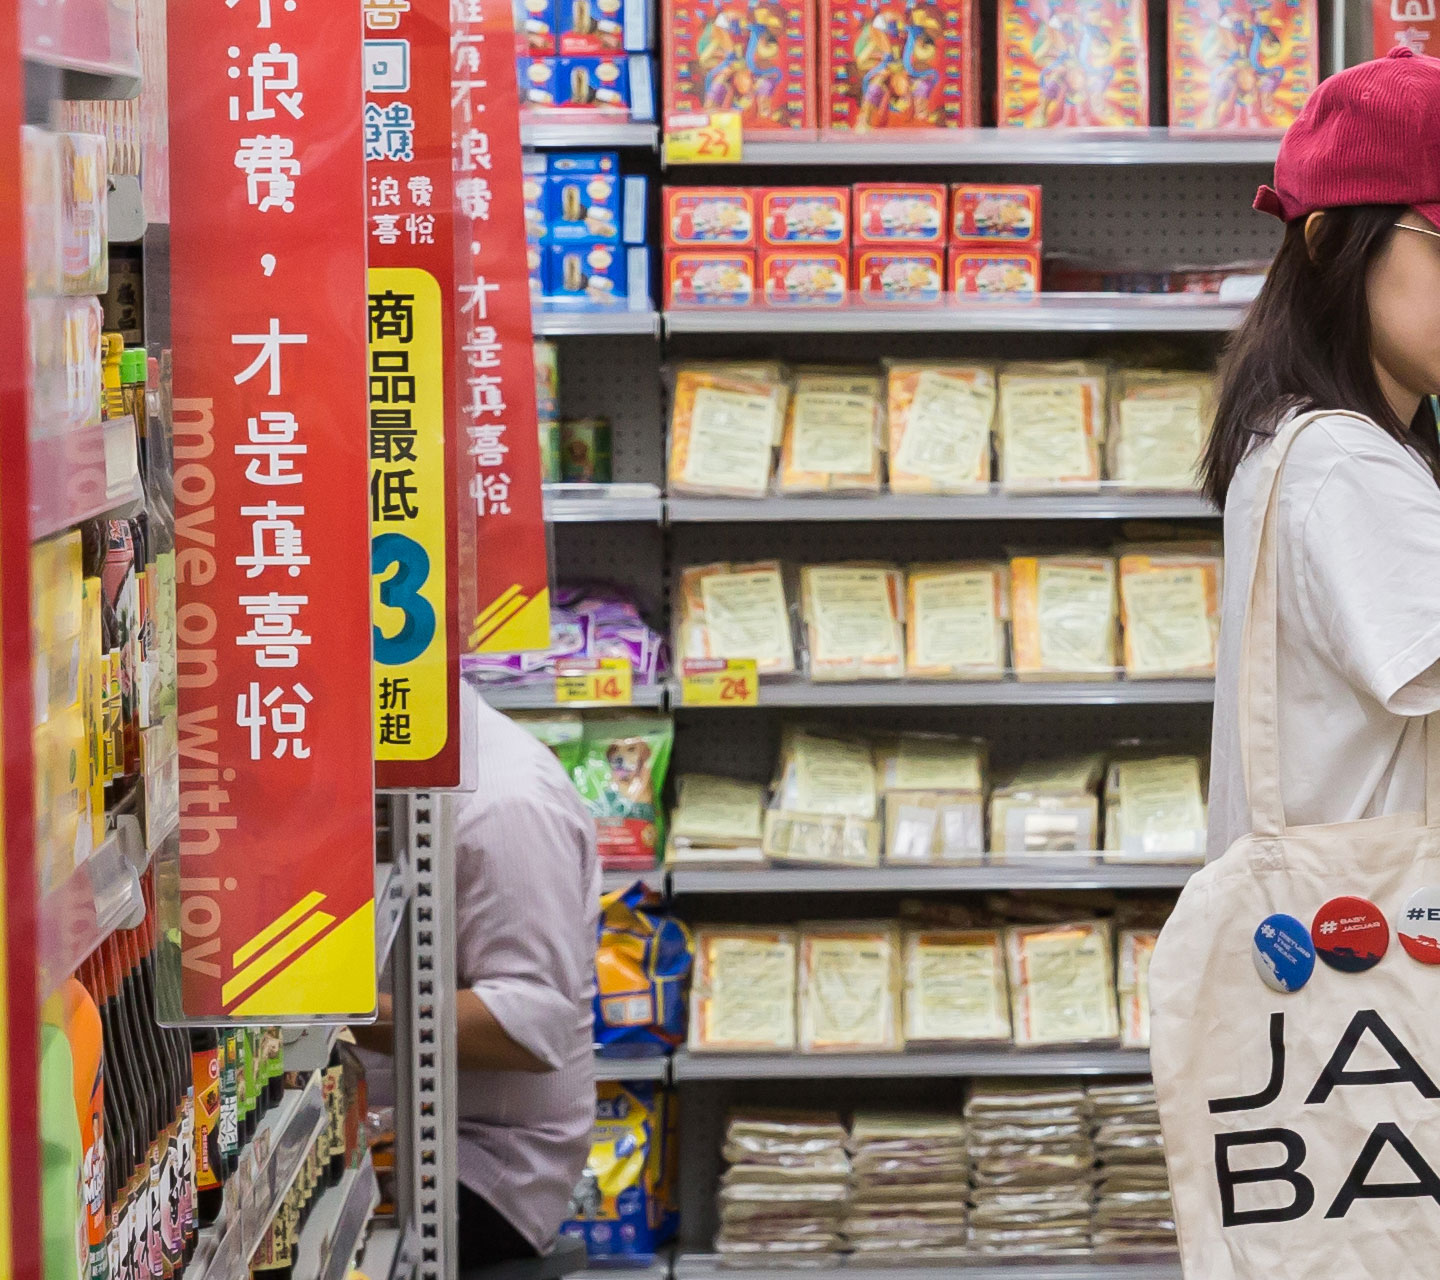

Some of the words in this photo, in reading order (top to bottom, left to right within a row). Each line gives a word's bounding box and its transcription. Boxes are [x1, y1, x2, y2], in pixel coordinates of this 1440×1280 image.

[368, 290, 419, 522] 商品最低
[175, 397, 218, 586] move
[177, 605, 218, 693] on
[372, 532, 432, 666] 3
[379, 677, 412, 745] 折起
[179, 707, 238, 858] with
